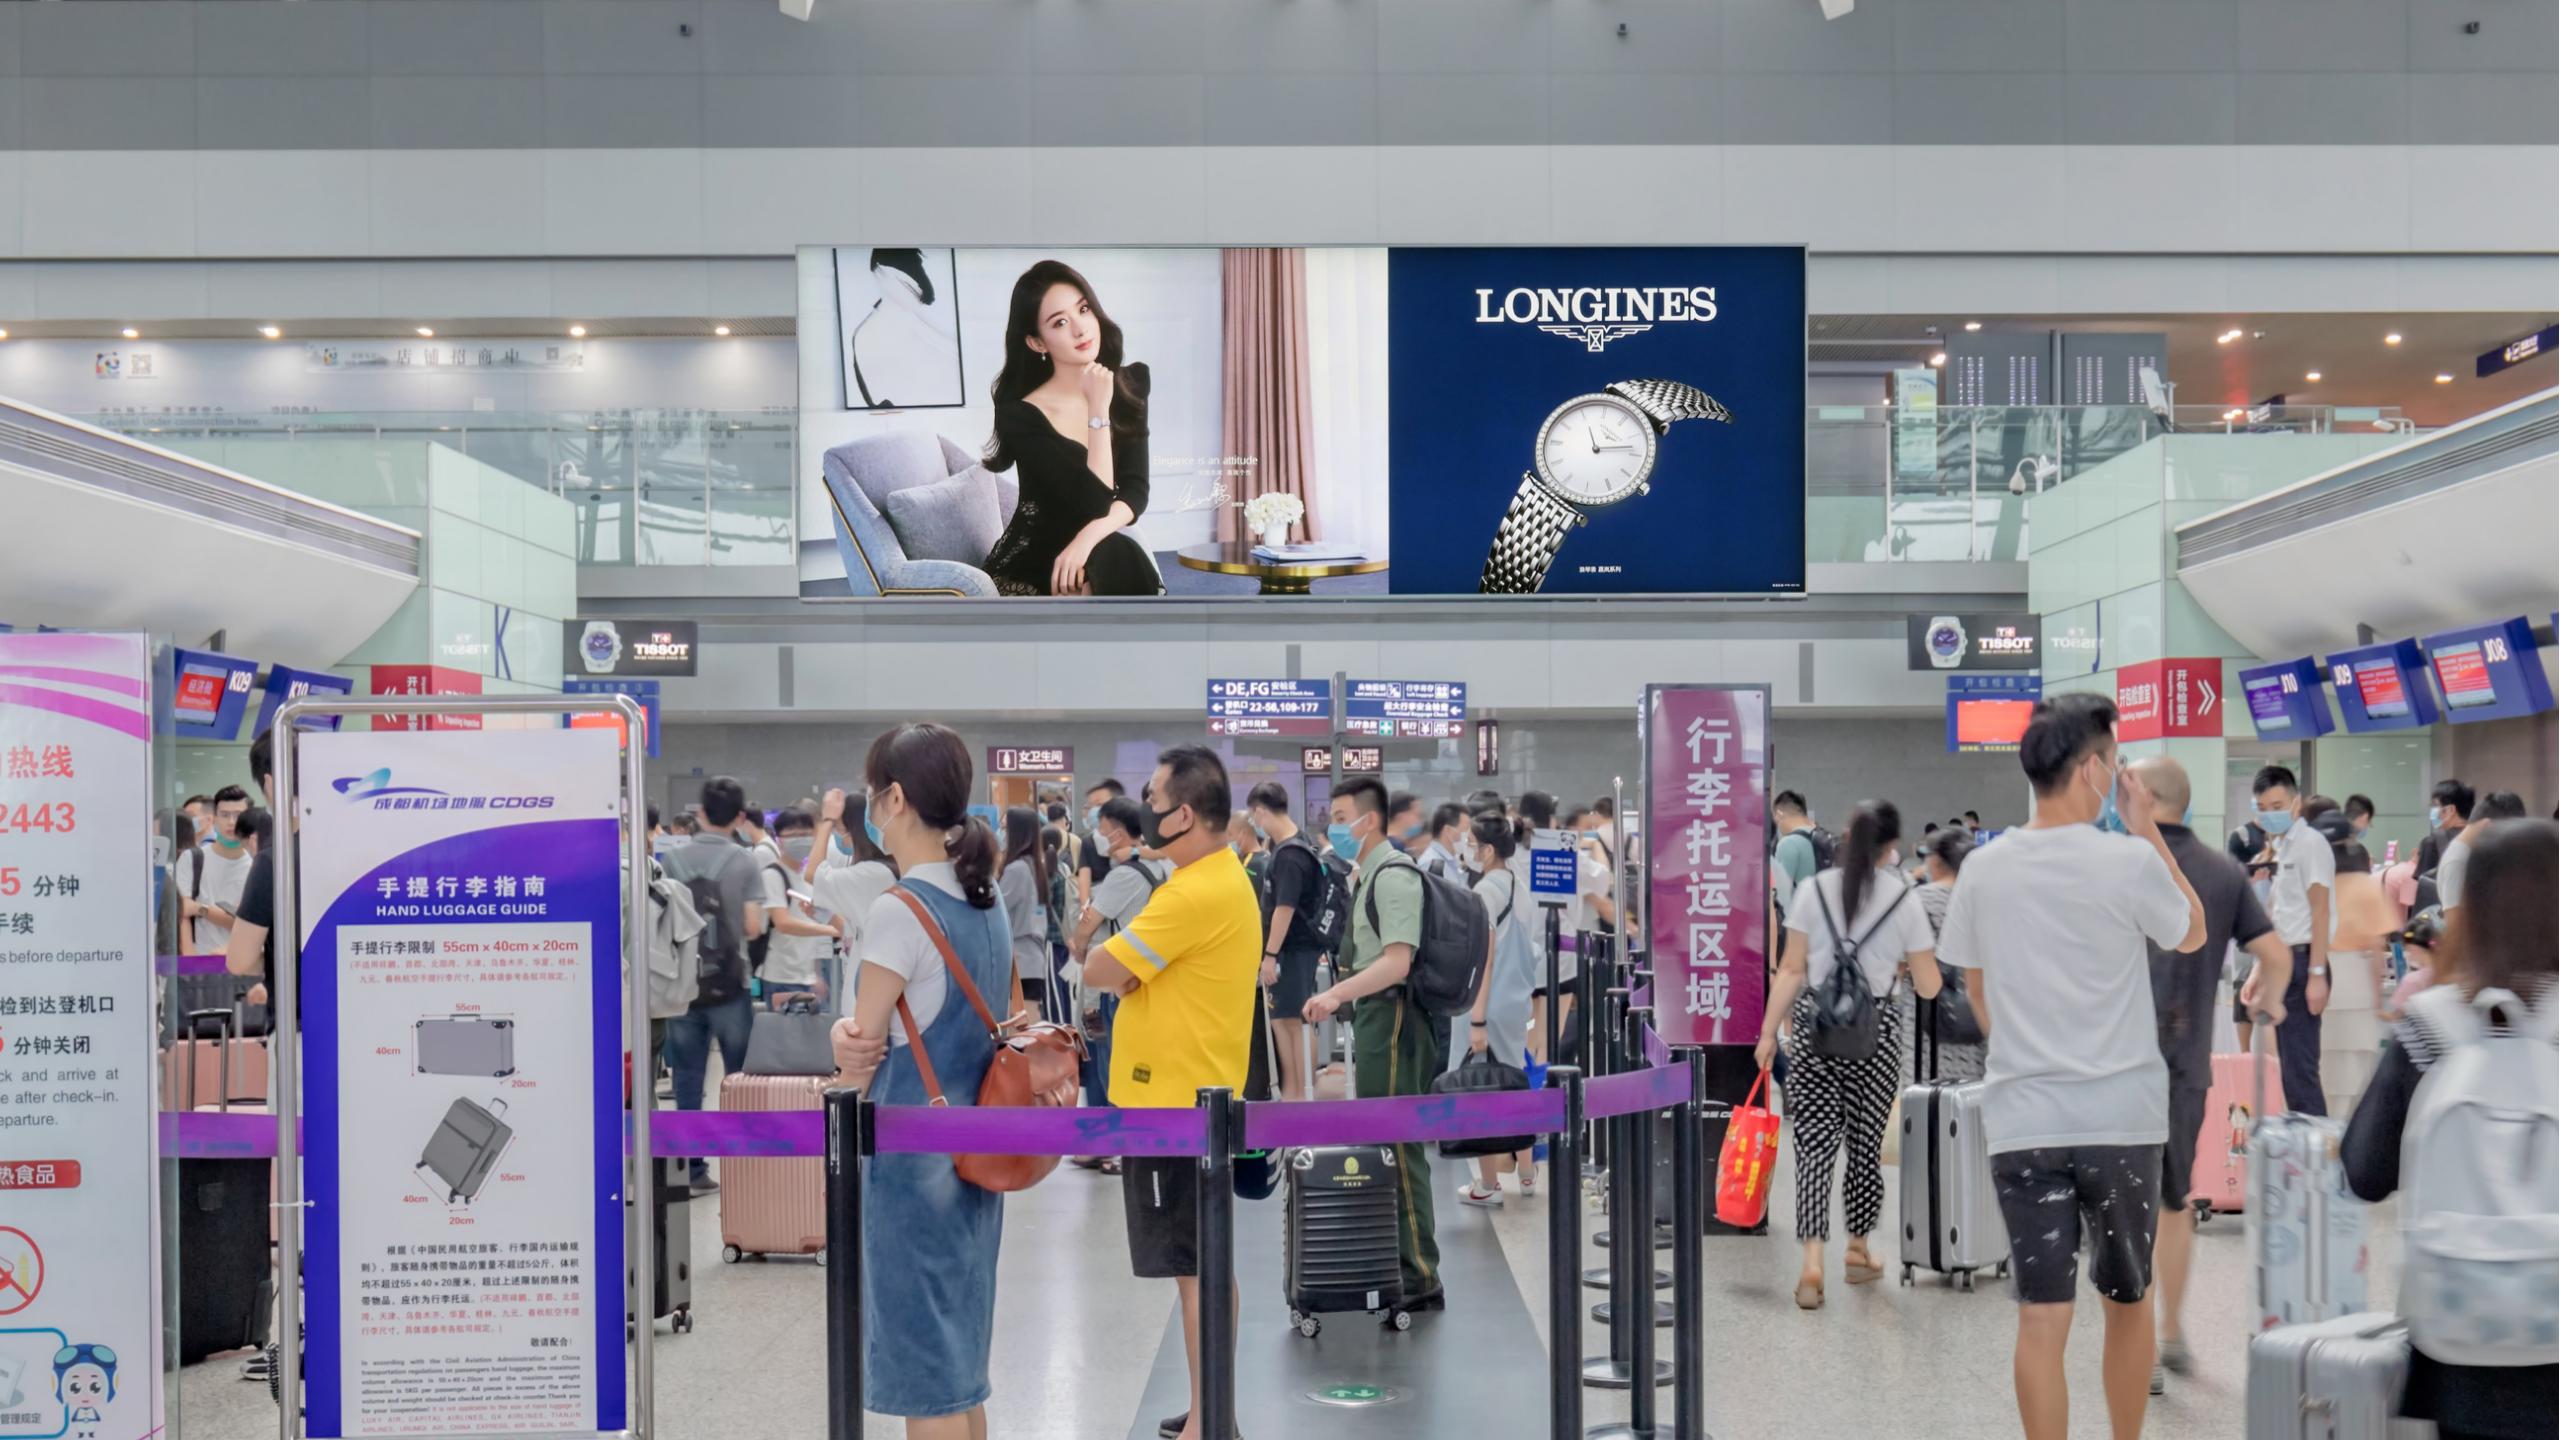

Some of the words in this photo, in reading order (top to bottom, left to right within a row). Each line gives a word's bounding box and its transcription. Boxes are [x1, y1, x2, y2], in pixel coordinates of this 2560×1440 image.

[1476, 287, 1717, 322] LONGINES
[1223, 455, 1258, 465] attitude
[634, 644, 689, 656] TISSOT
[1978, 638, 2034, 650] TISSOT
[2484, 637, 2509, 663] J08
[228, 670, 252, 693] K09
[2333, 664, 2353, 686] J09
[1225, 682, 1269, 697] DE,FG
[2280, 672, 2299, 694] J10
[0, 745, 74, 779] 热线
[1019, 750, 1063, 763] 女卫生间
[374, 797, 486, 810] 成都机场地服
[489, 796, 555, 809] CDGS
[1686, 716, 1732, 1021] 行李托运区域
[33, 874, 80, 897] 分钟
[377, 874, 546, 899] 手提行李指南
[376, 905, 420, 917] HAND
[423, 904, 497, 916] LUGGAGE
[501, 903, 547, 915] GUIDE
[351, 940, 435, 955] 手提行李限制
[443, 941, 479, 953] 55cm
[493, 940, 529, 952] 40cm
[543, 939, 579, 951] 20cm
[9, 950, 53, 963] before
[57, 949, 123, 964] departure
[0, 996, 114, 1015] 检到达登机口
[455, 1003, 481, 1012] 55cm
[14, 1035, 90, 1055] 分钟关闭
[375, 1047, 401, 1056] 40cm
[22, 1069, 48, 1081] and
[57, 1068, 96, 1081] arrive
[106, 1068, 119, 1080] at
[511, 1079, 537, 1088] 20cm
[15, 1092, 47, 1104] after
[500, 1173, 526, 1182] 55cm
[402, 1194, 429, 1204] 40cm
[449, 1216, 475, 1226] 20cm
